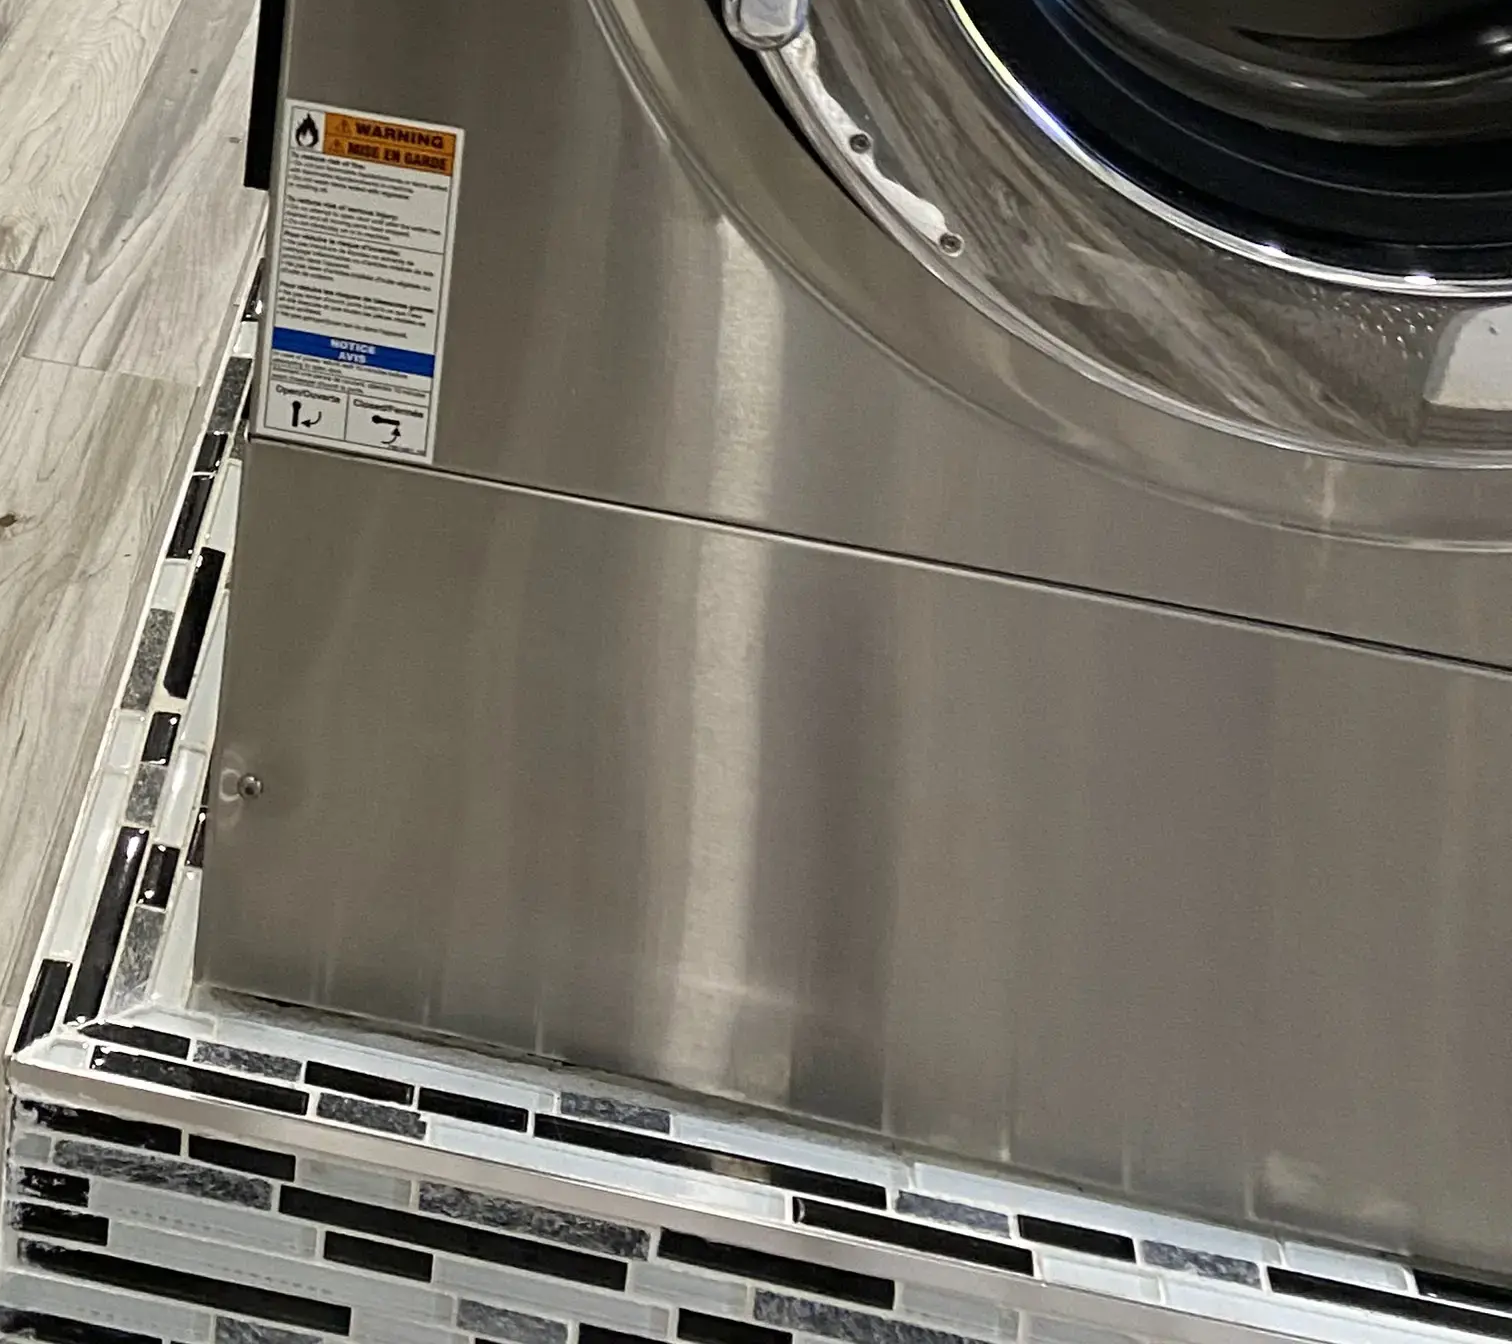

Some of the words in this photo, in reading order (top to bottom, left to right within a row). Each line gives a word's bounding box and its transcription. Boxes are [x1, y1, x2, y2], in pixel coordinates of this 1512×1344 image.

[355, 123, 444, 148] WARNING
[403, 152, 447, 170] GARDE
[329, 339, 376, 355] NOTICE
[337, 351, 366, 363] AVIS
